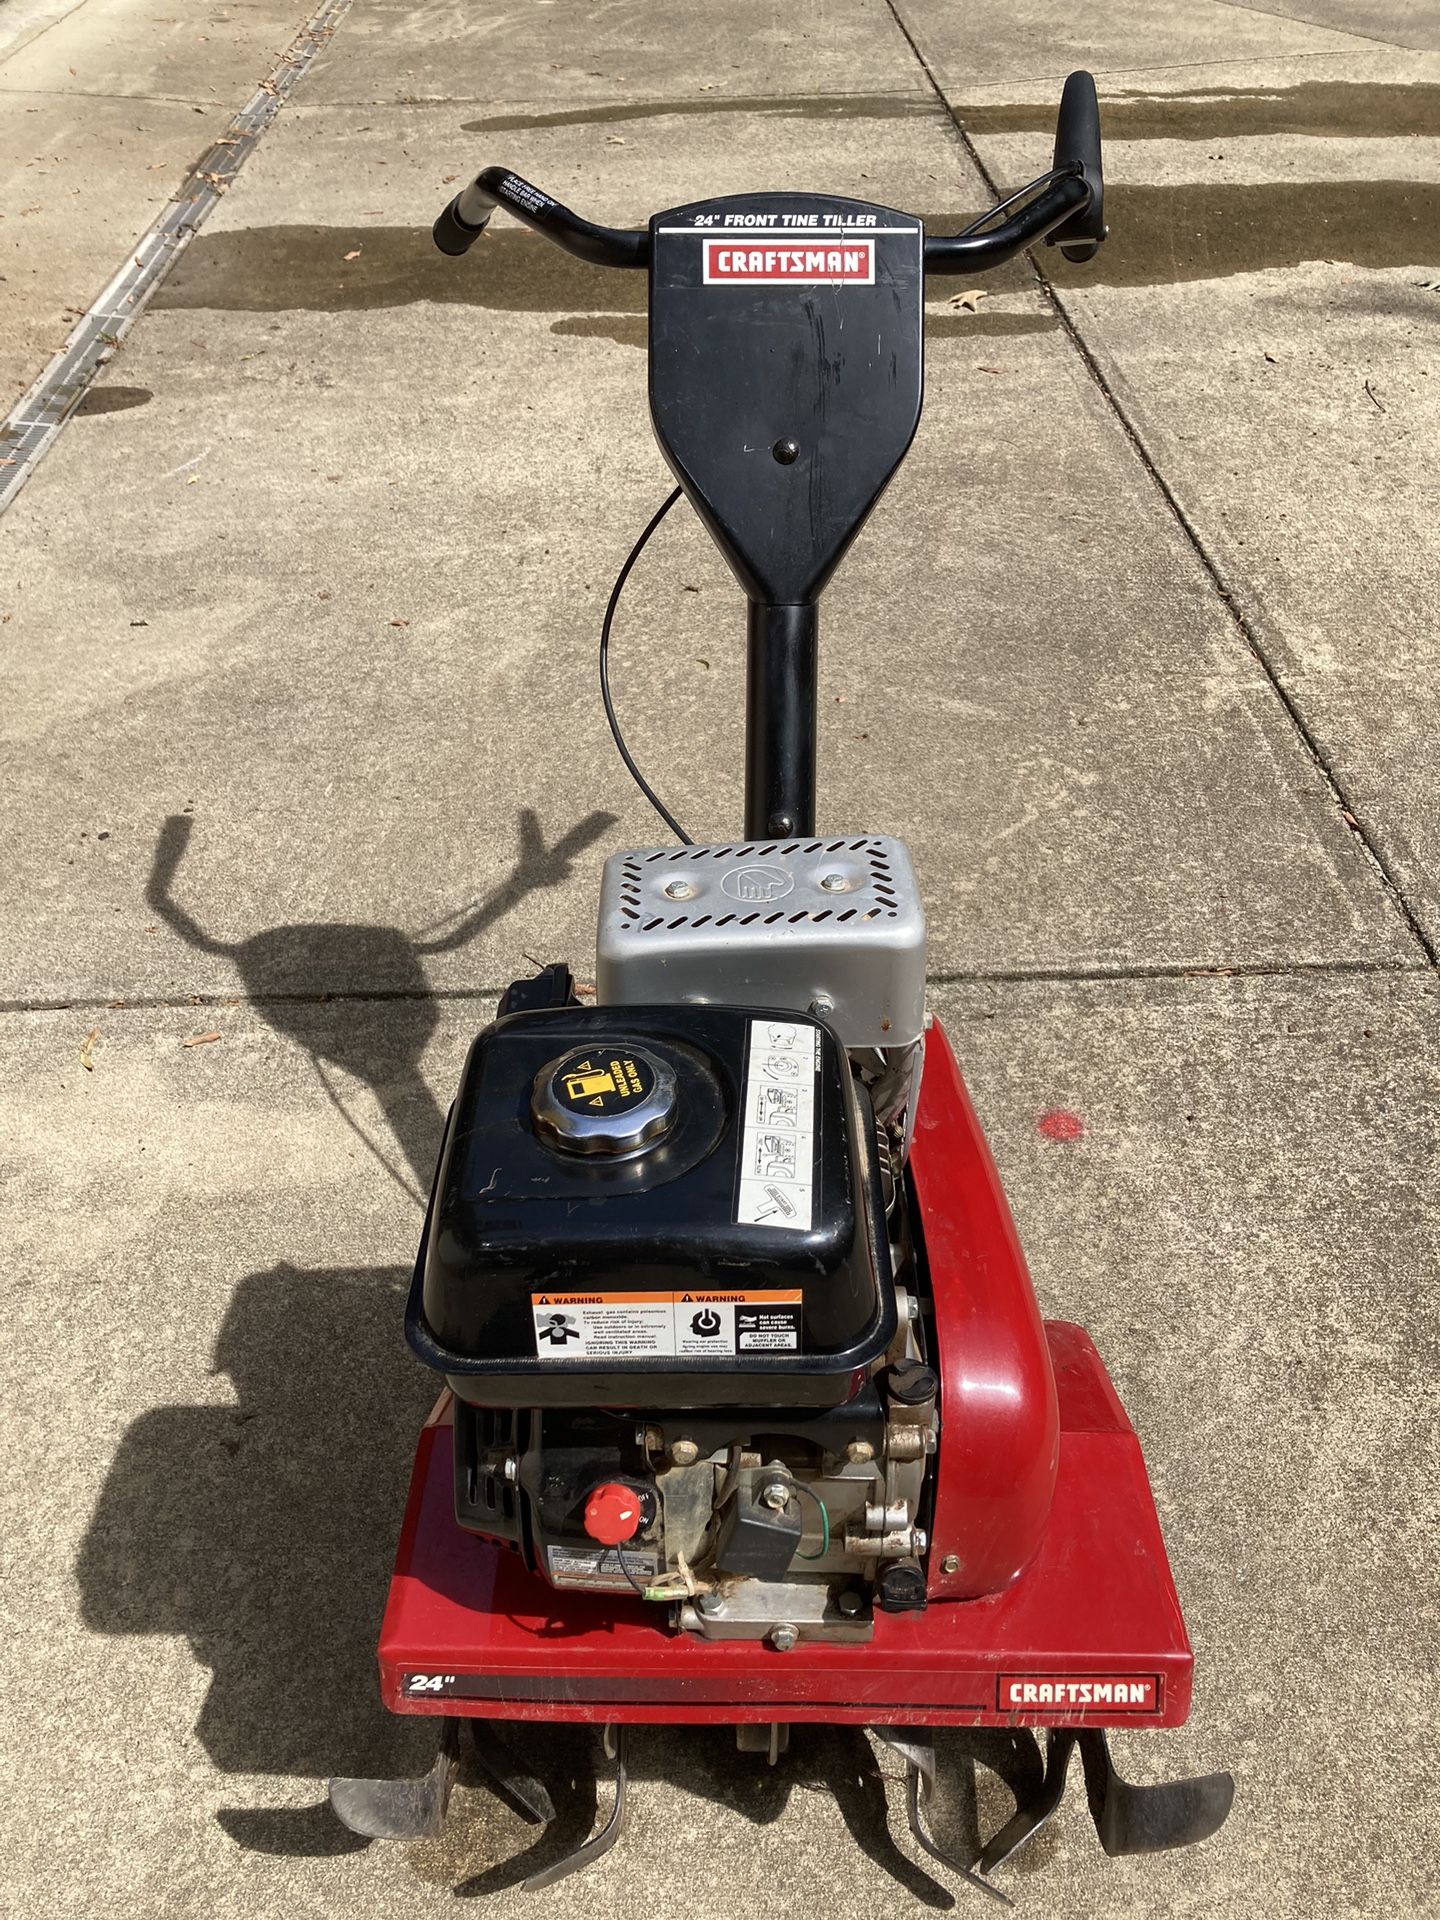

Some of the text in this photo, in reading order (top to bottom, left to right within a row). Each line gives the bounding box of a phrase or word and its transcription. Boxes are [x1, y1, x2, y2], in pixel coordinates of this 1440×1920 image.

[502, 180, 545, 208] HANDLE BAR WHEN
[693, 214, 877, 227] 24" FRONT TINE TILLER
[609, 1060, 631, 1097] UNLEADED
[622, 1060, 643, 1093] GAS ONLY
[409, 1674, 455, 1691] 24"
